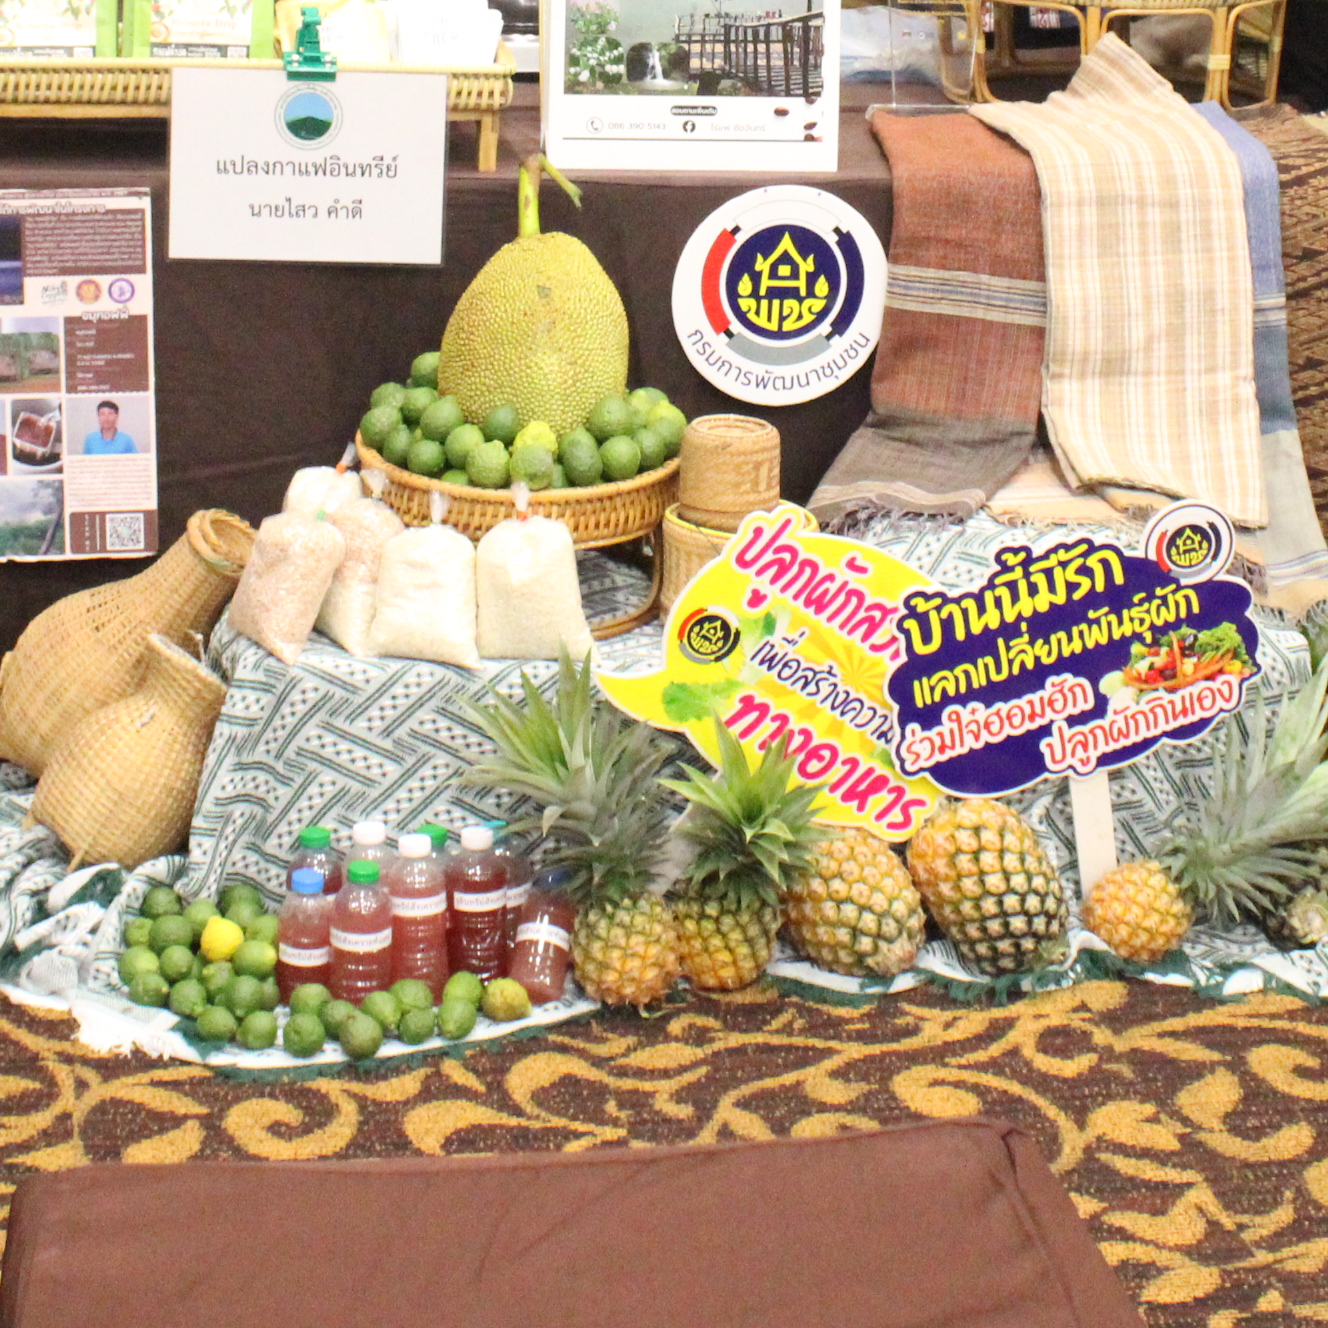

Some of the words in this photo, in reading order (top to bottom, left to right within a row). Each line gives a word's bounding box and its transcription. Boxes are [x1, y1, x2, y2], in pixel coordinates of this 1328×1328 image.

[215, 154, 400, 179] แปลงกาแฟอินทรีย์
[248, 197, 319, 219] นายไสว
[326, 198, 364, 220] คำดี
[686, 327, 871, 391] กรมการพัฒนาชุมชน
[903, 544, 1125, 655] บ้านนี้มีรัก
[912, 584, 1200, 709] แลกเปลี่ยนพันธุ์ผัก
[1044, 678, 1237, 768] ปลูกผักกินเอง
